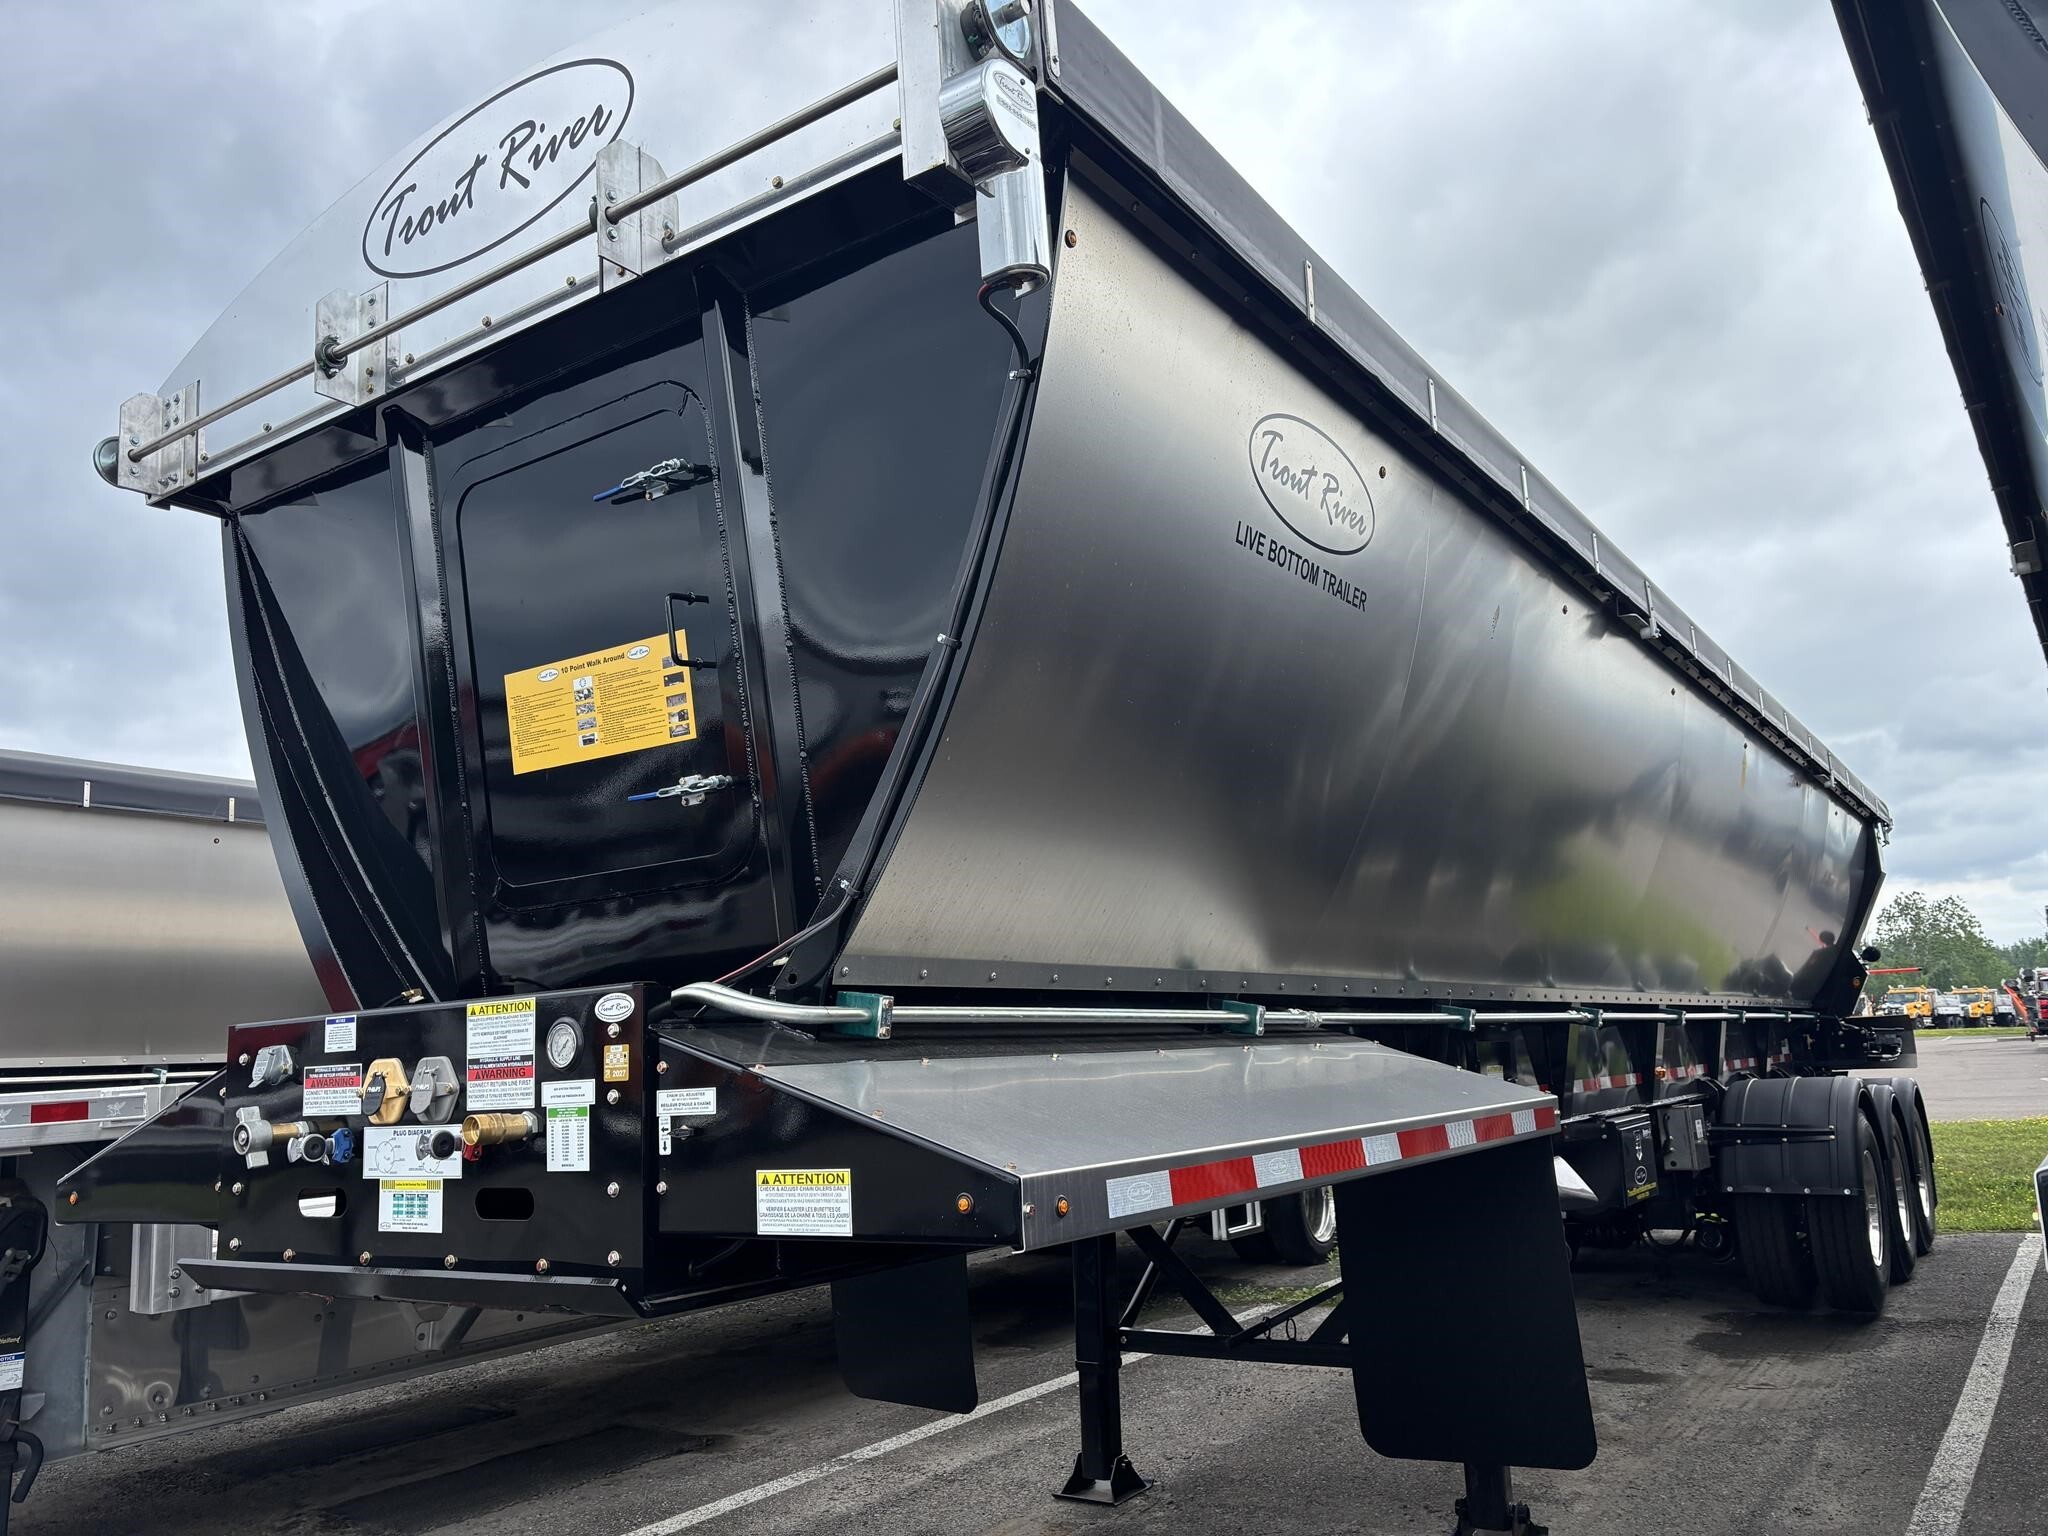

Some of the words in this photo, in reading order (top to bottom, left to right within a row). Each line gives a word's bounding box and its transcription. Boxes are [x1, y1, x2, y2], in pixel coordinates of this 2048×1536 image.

[381, 153, 488, 257] Trout
[499, 103, 613, 190] River
[1260, 430, 1318, 501] Trout
[1320, 472, 1367, 536] River
[1235, 520, 1267, 557] LIVE
[1267, 538, 1320, 586] BOTTOM
[1322, 569, 1368, 612] TRAILER
[561, 667, 569, 675] 10
[569, 663, 586, 673] Point
[586, 658, 602, 669] Walk
[603, 652, 626, 665] Around
[479, 1001, 531, 1015] ATTENTION
[482, 1068, 526, 1079] WARNING
[612, 1069, 626, 1078] 2027
[316, 1077, 354, 1088] WARNING
[773, 1173, 845, 1185] ATTENTION
